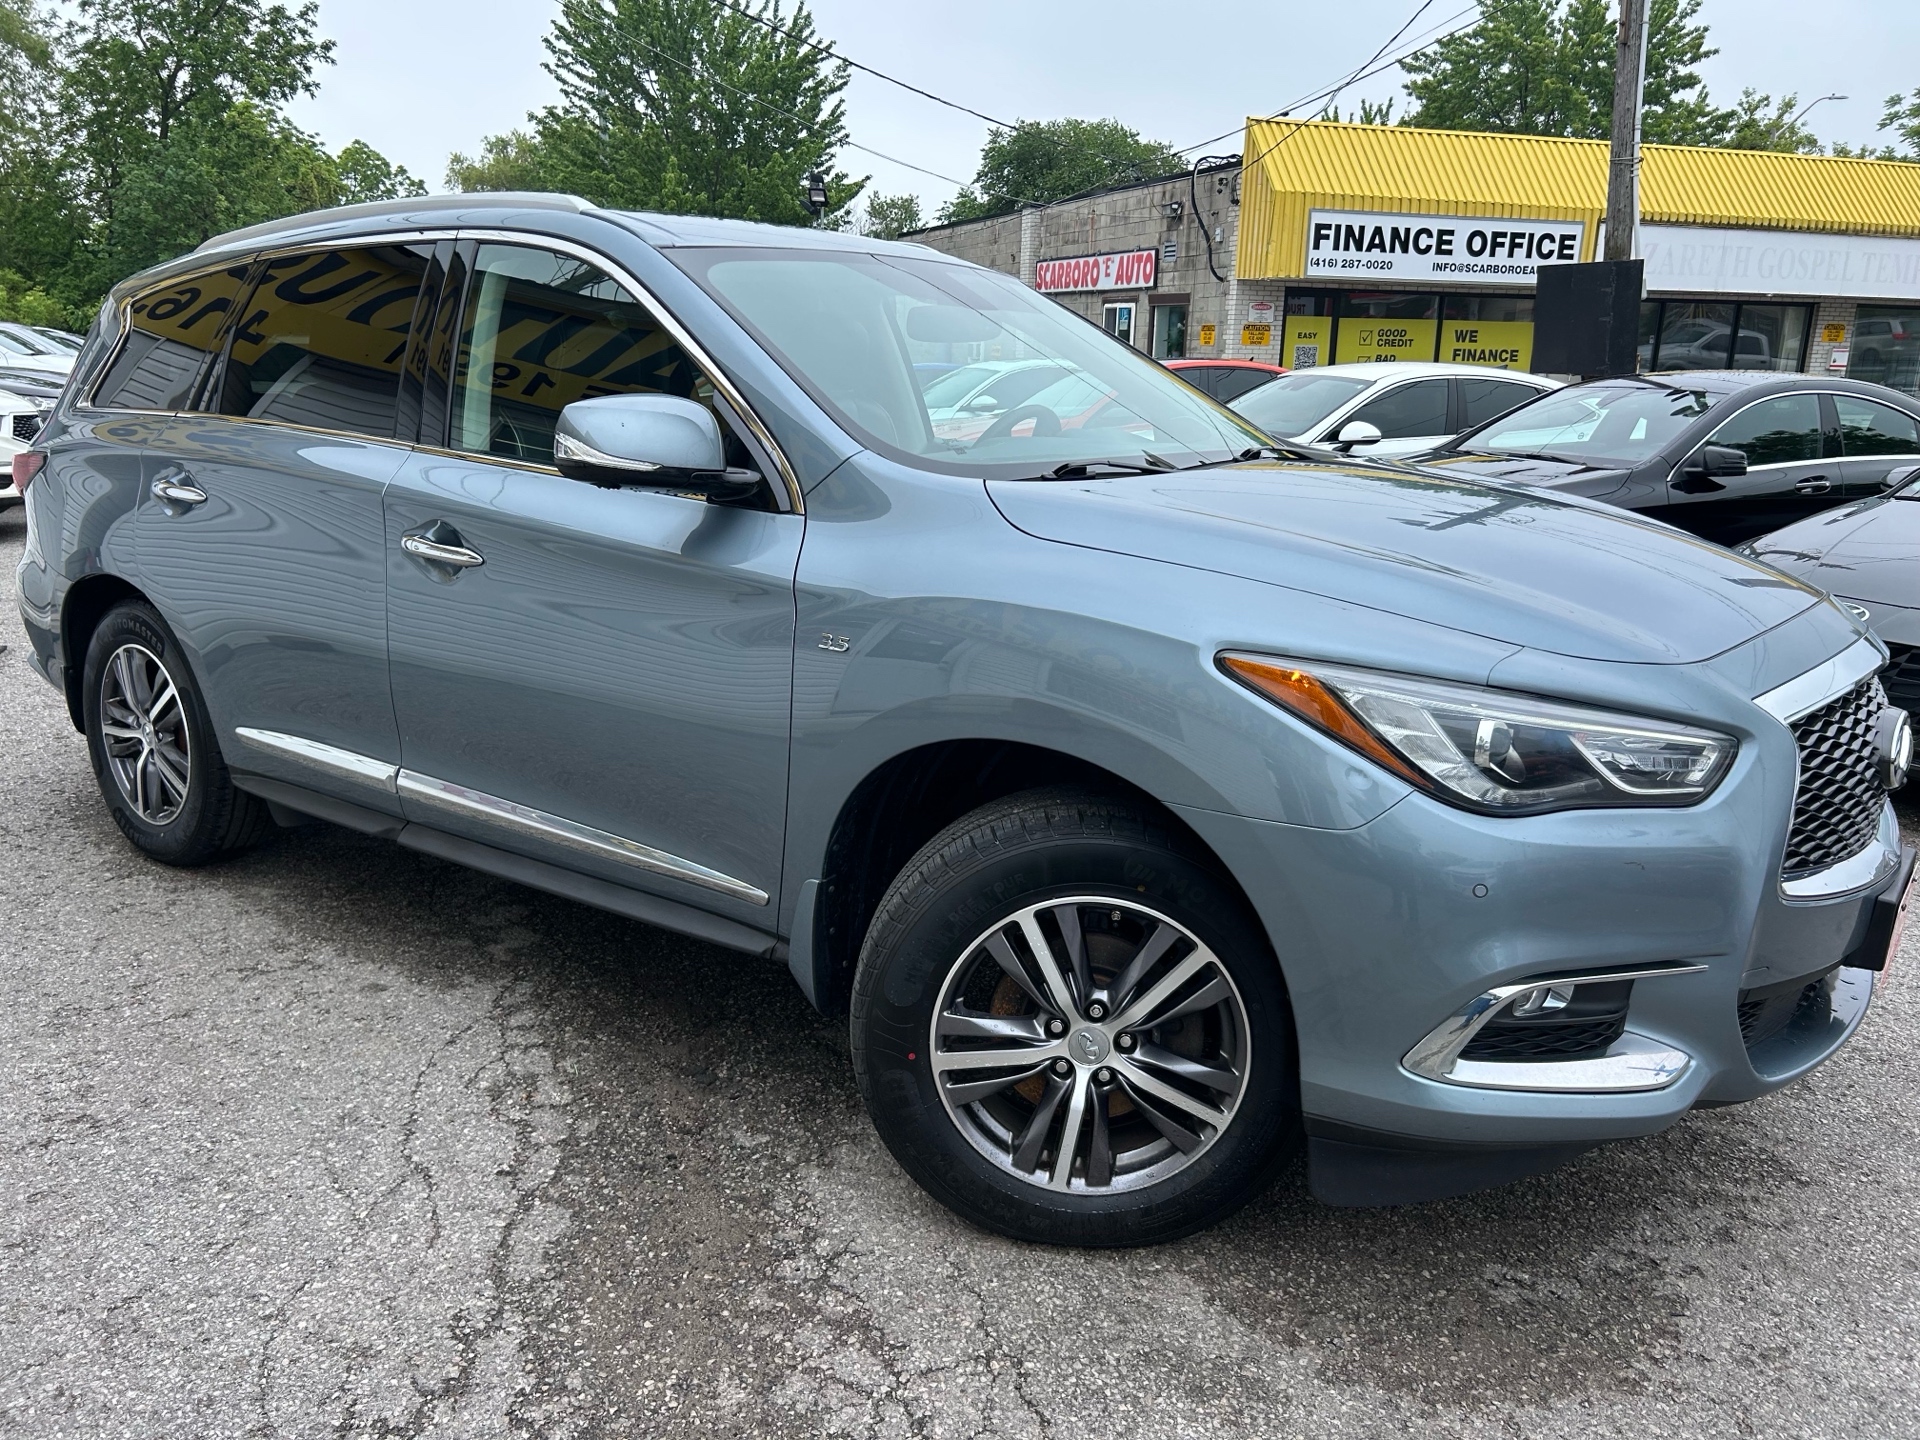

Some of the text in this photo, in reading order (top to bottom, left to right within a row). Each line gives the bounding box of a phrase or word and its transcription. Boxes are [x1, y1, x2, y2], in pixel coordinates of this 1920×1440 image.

[1312, 222, 1577, 261] FINANCE OFFICE
[1036, 259, 1100, 289] SCARBORO
[1115, 252, 1153, 285] AUTO
[1310, 257, 1538, 276] (416) 287-0020 INFO@SCARBOROEA
[1757, 246, 1854, 283] GOSPEL
[1377, 328, 1407, 338] GOOD
[1455, 329, 1478, 343] WE
[1376, 338, 1414, 347] CREDIT
[1375, 354, 1396, 363] BAD
[1452, 349, 1519, 363] FINANCE
